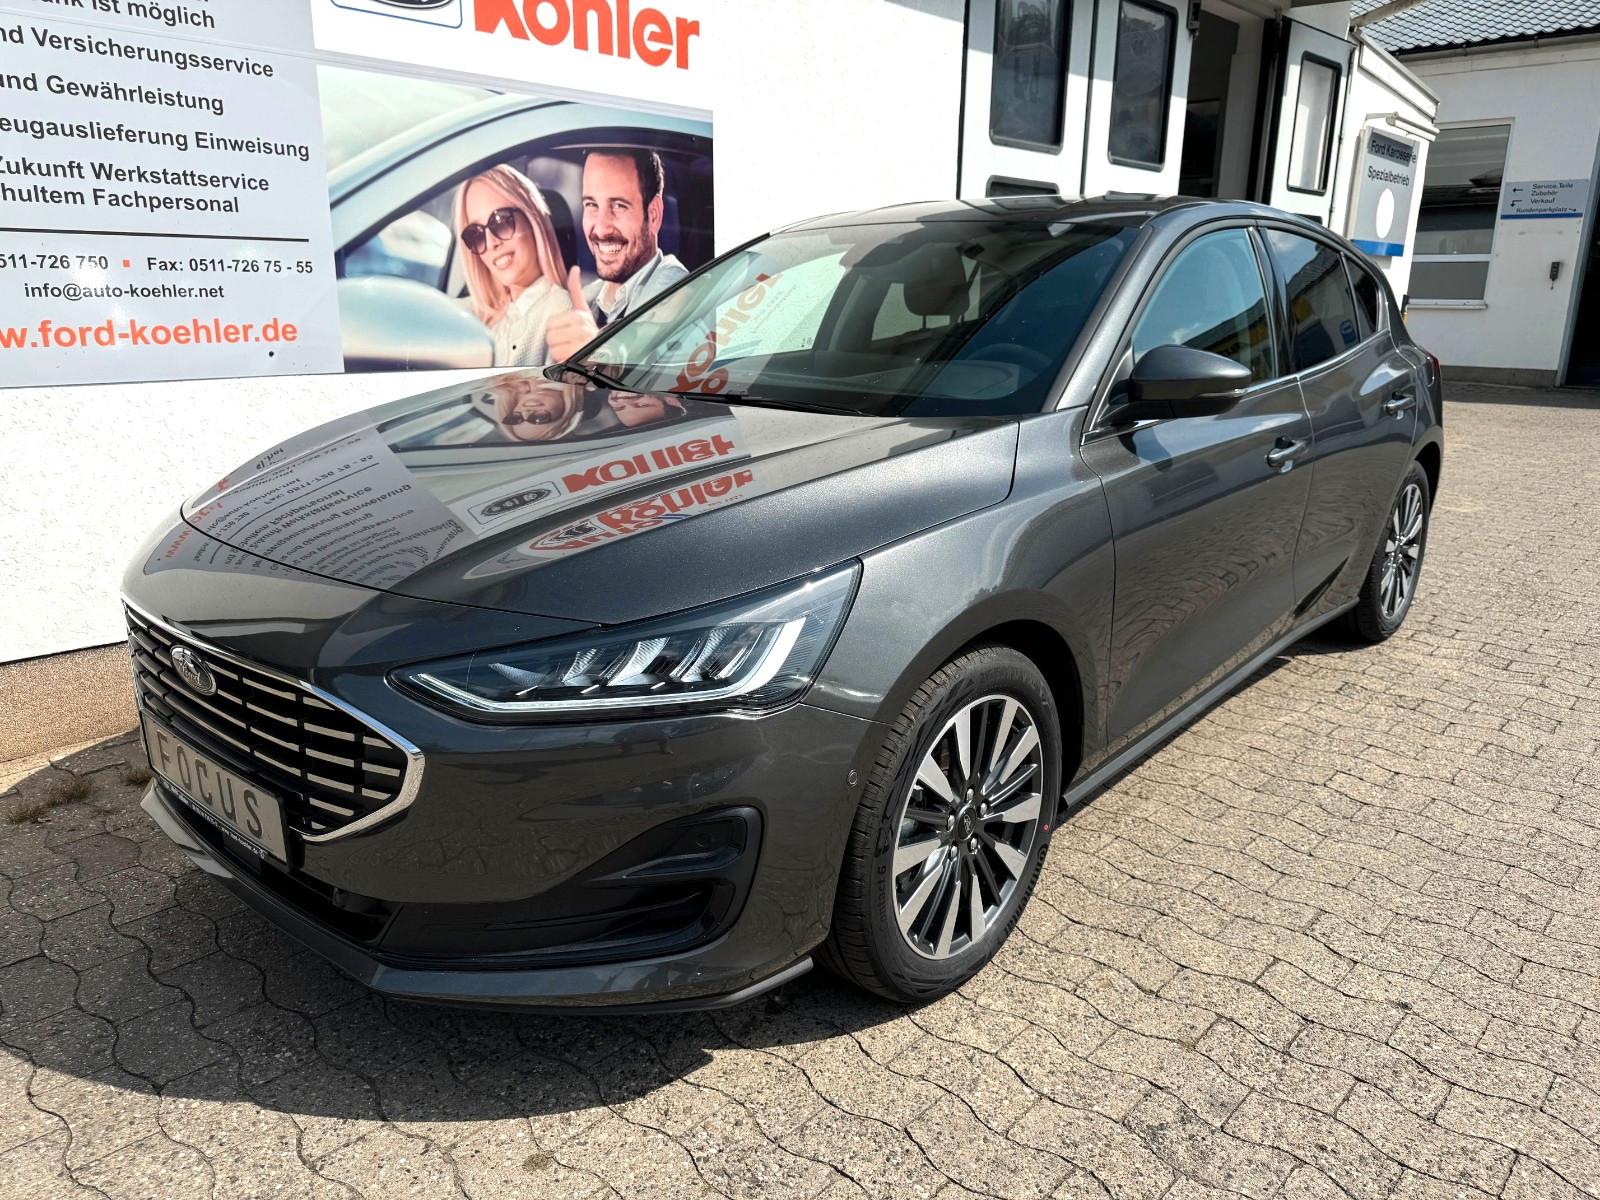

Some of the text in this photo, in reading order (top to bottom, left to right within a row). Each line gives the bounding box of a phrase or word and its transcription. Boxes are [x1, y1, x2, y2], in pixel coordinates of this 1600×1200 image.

[128, 2, 216, 29] möglich
[30, 26, 274, 77] Versicherungsservice
[46, 74, 224, 115] Gewährleistung
[0, 117, 310, 161] eugauslieferung Einweisung
[1370, 140, 1386, 155] Ford
[90, 161, 270, 191] Werkstattservice
[1368, 165, 1410, 187] Spezialbetrieb
[1, 183, 239, 213] hultem Fachpersonal
[1530, 197, 1556, 205] Verkauf
[75, 255, 109, 270] 750
[147, 257, 183, 272] Fax:
[189, 258, 260, 274] 0511-726
[264, 259, 282, 274] 75
[296, 260, 313, 275] 55
[24, 282, 225, 301] info@auto-koehler.net
[156, 729, 263, 840] FOCUS
